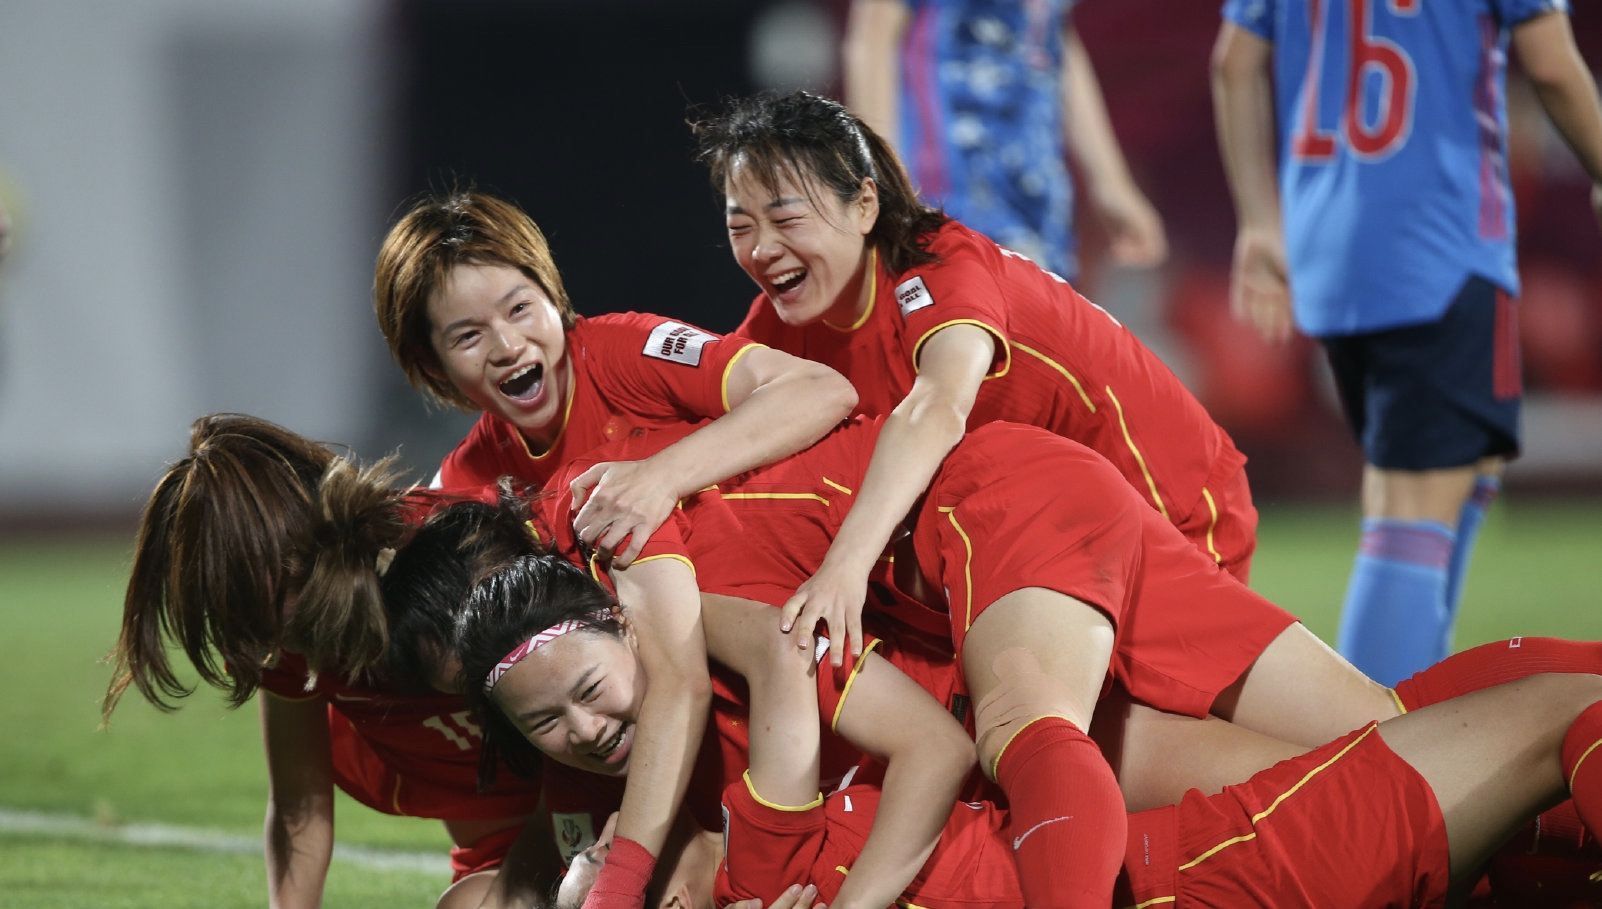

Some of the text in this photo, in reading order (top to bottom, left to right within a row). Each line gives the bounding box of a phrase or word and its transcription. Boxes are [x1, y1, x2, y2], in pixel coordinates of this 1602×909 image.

[1290, 0, 1418, 164] 16
[905, 292, 920, 304] ALL
[661, 337, 675, 356] OUR
[674, 336, 689, 355] FOR
